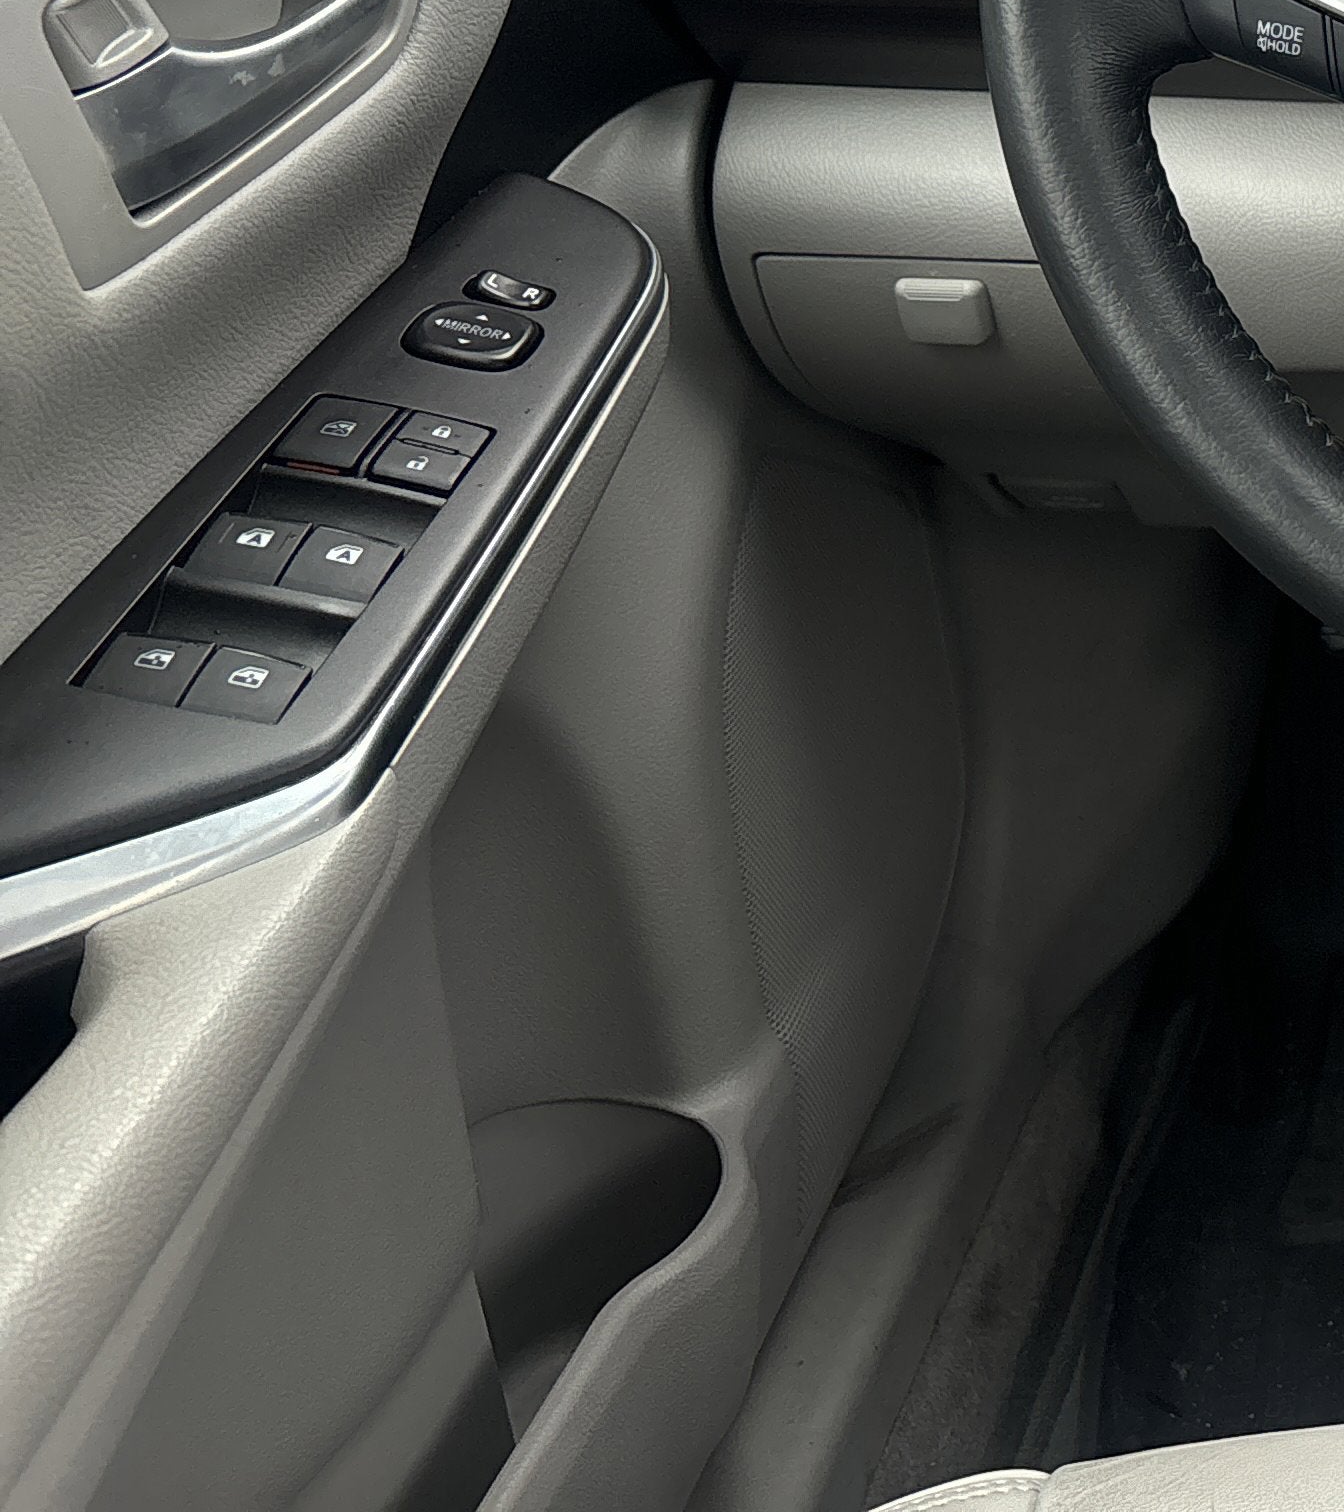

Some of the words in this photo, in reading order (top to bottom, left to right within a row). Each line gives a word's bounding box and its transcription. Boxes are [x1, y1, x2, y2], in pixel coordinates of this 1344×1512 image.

[1256, 19, 1305, 44] MODE
[1266, 38, 1301, 56] HOLD
[487, 272, 499, 289] L
[521, 287, 540, 300] R
[442, 318, 503, 340] MIRROR
